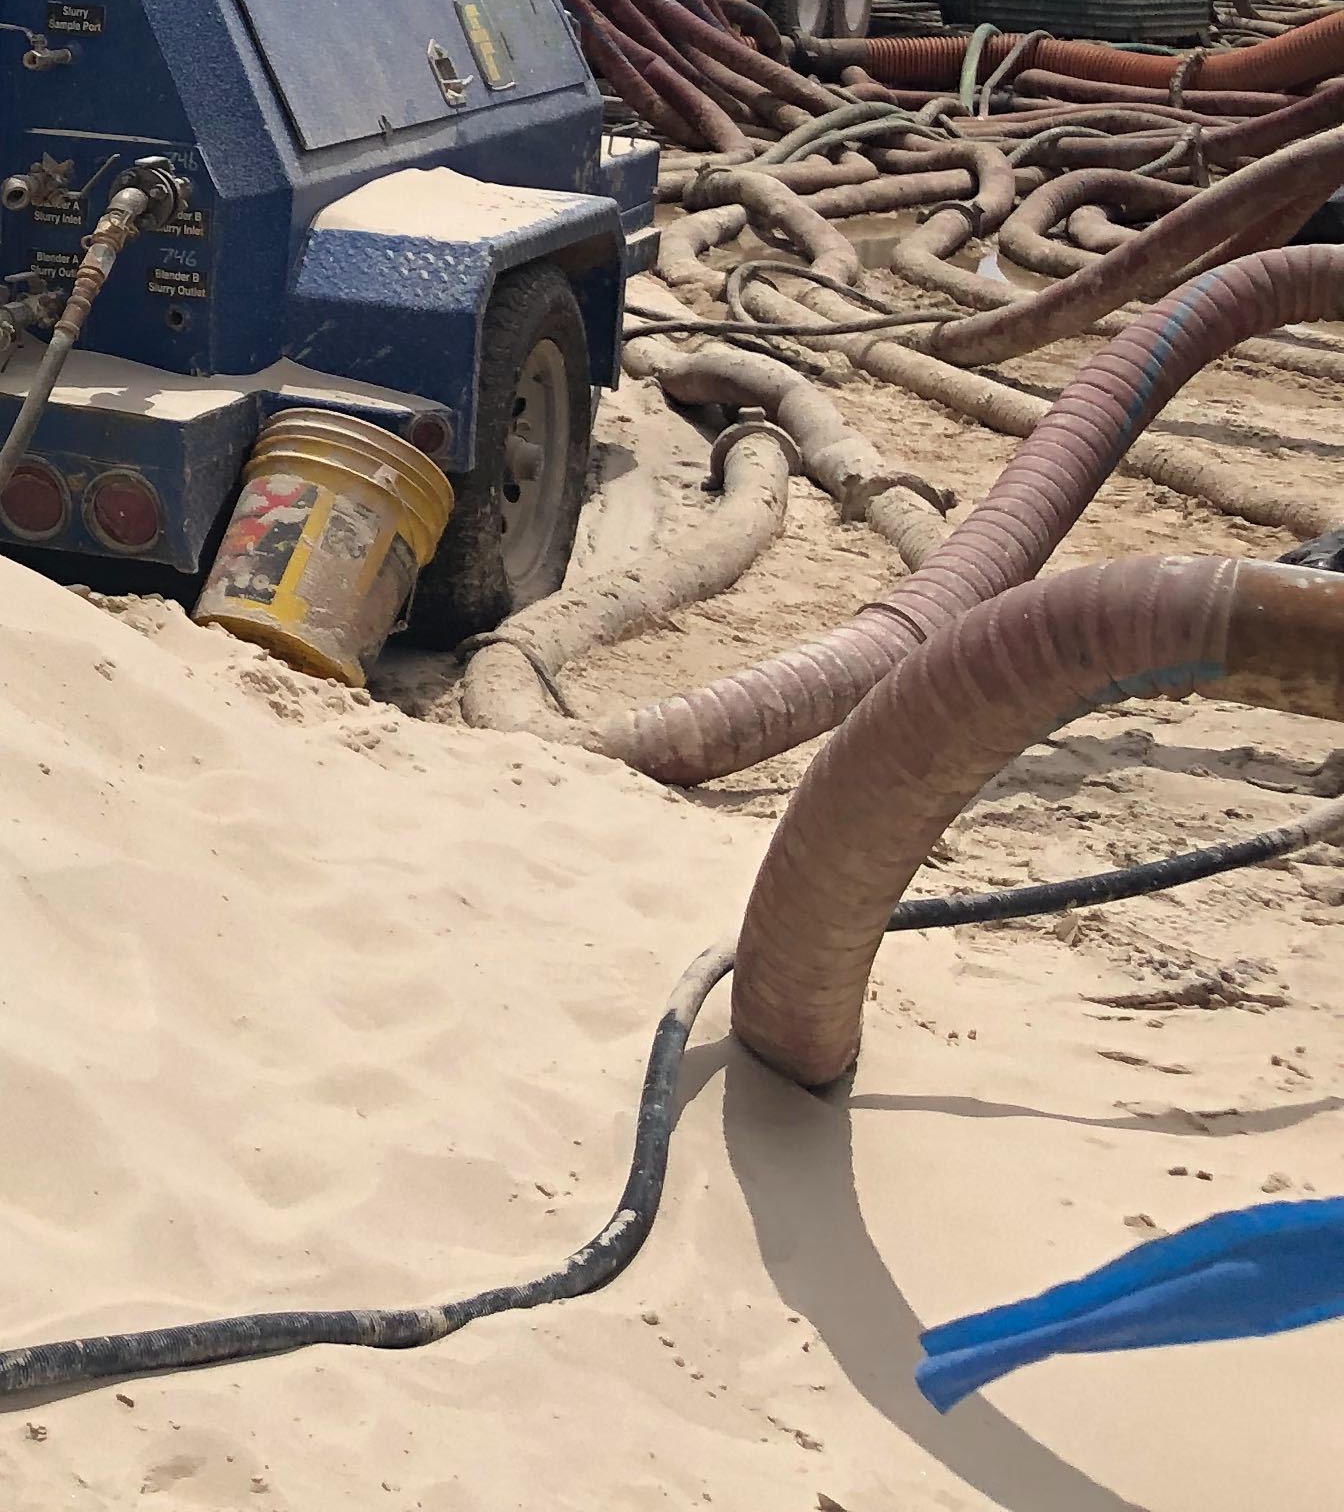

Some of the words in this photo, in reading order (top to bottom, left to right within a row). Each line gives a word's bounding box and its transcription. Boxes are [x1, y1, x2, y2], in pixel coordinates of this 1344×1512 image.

[62, 5, 89, 19] Slurry
[48, 18, 81, 31] Sample
[82, 21, 102, 32] Port
[34, 210, 61, 225] Slurry
[62, 213, 82, 225] Inlet
[36, 251, 70, 264] Blender
[72, 254, 79, 264] A
[160, 248, 198, 268] 746
[155, 268, 190, 282] Blender
[192, 272, 200, 283] B
[148, 281, 176, 297] Slurry
[177, 285, 206, 298] Outlet
